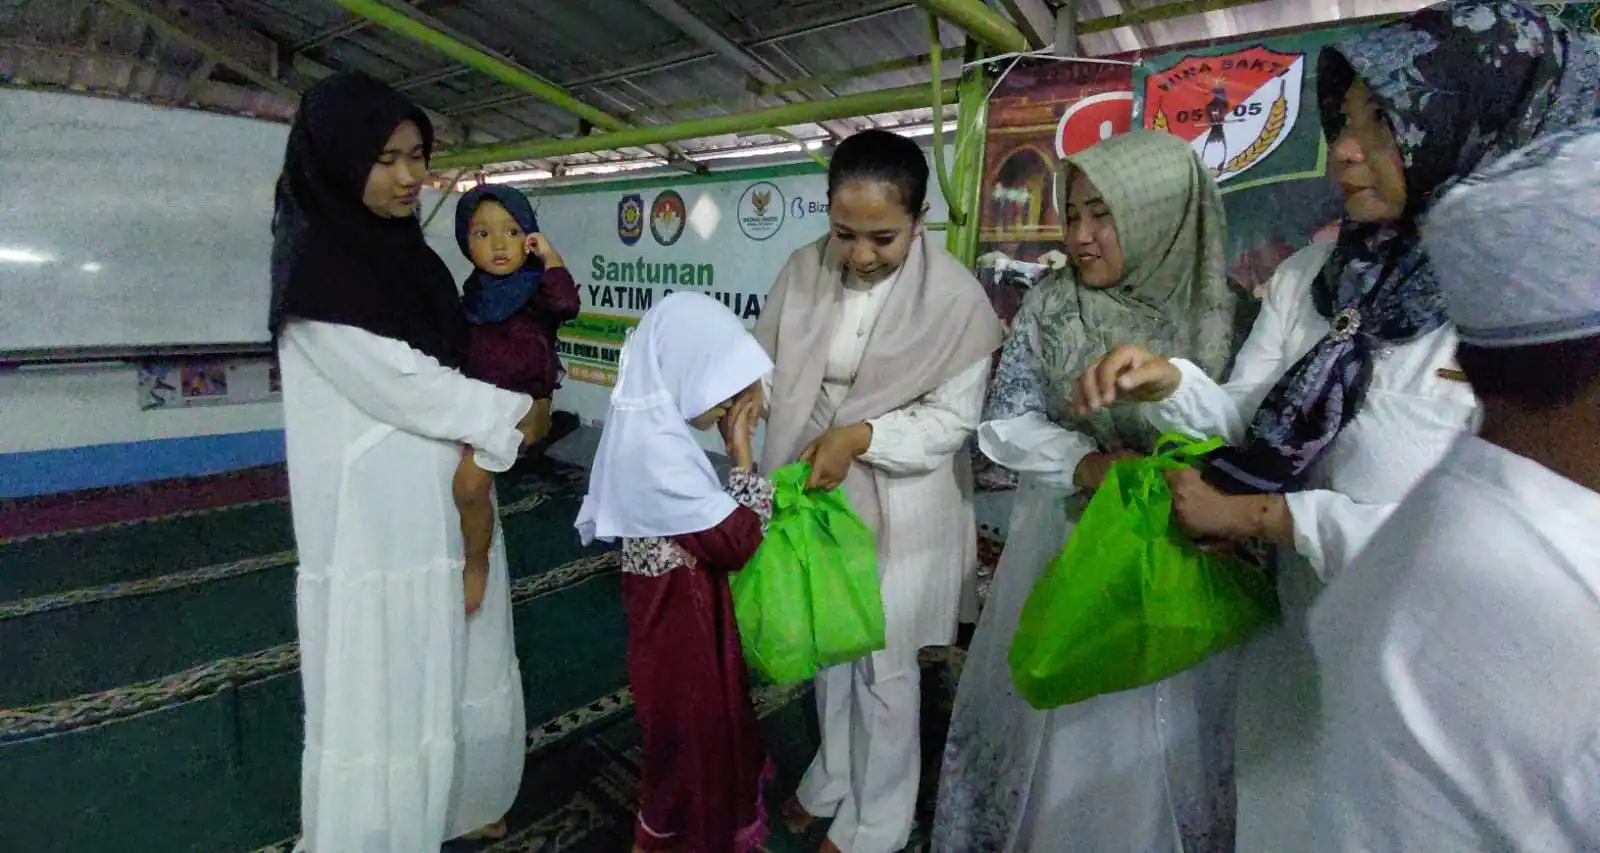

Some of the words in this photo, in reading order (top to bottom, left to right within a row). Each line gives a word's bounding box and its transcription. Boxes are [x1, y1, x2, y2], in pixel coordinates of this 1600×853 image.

[1176, 109, 1203, 123] 05
[1233, 102, 1263, 117] 05
[591, 254, 714, 286] Santunan
[588, 284, 653, 311] YATIM
